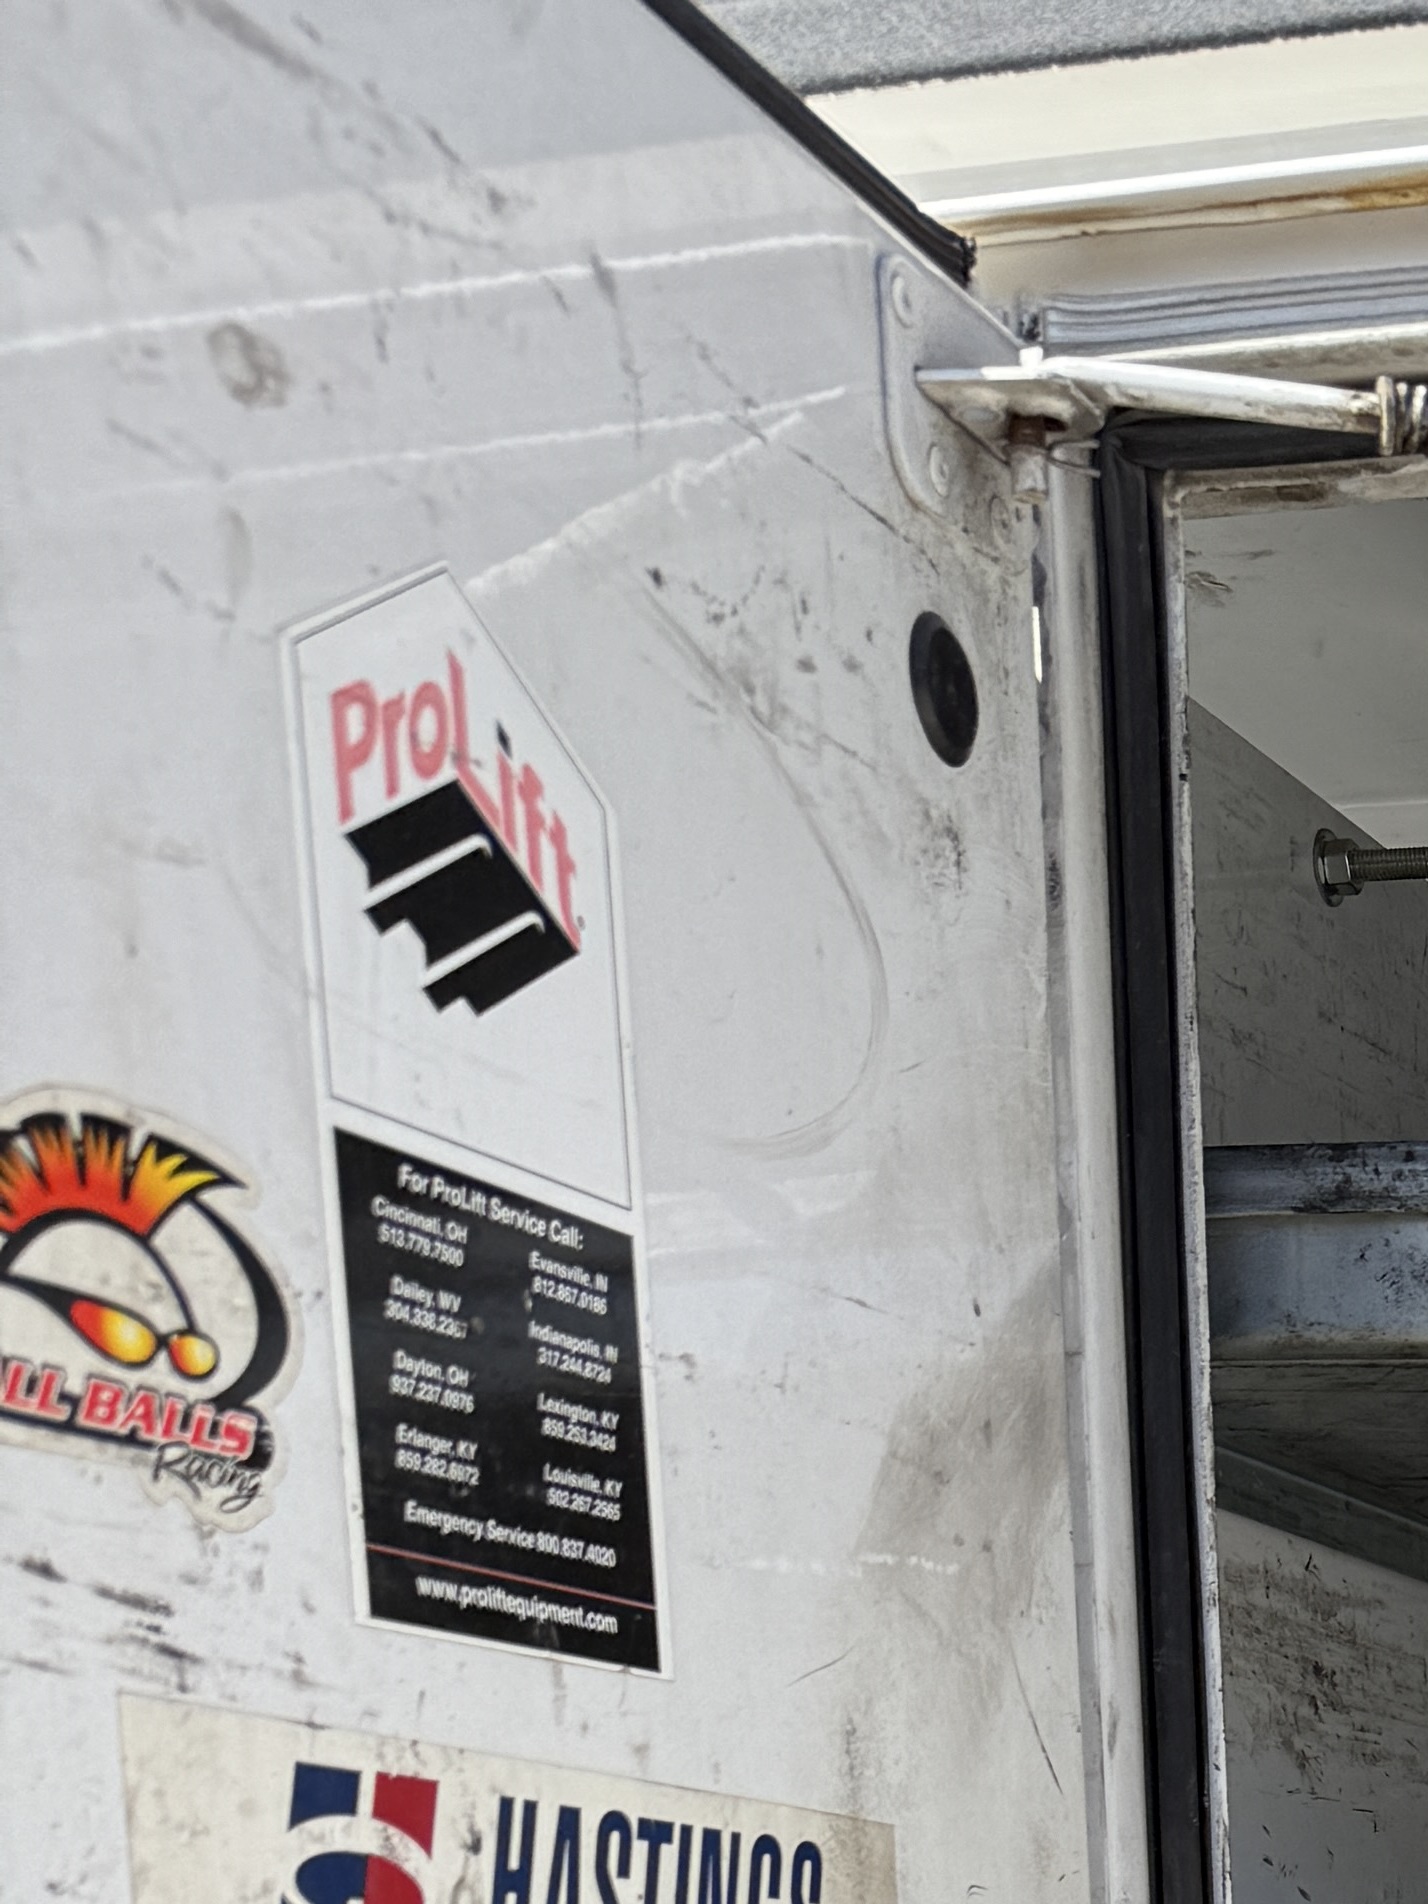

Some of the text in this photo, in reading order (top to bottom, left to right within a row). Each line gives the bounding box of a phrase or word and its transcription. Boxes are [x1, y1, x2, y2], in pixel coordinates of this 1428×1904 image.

[397, 1164, 584, 1250] For ProLift Service Call:
[445, 1220, 468, 1244] OH
[594, 1273, 608, 1292] IN
[437, 1290, 462, 1313] WV
[605, 1345, 618, 1363] IN
[446, 1365, 469, 1388] OH
[0, 1358, 258, 1460] LL BALLS
[601, 1410, 620, 1430] KY
[456, 1440, 478, 1460] KY
[152, 1440, 263, 1513] Racing
[603, 1478, 623, 1498] KY
[404, 1500, 485, 1542] Emergency
[485, 1519, 535, 1550] Service
[415, 1574, 619, 1634] www.proliftequipment.com
